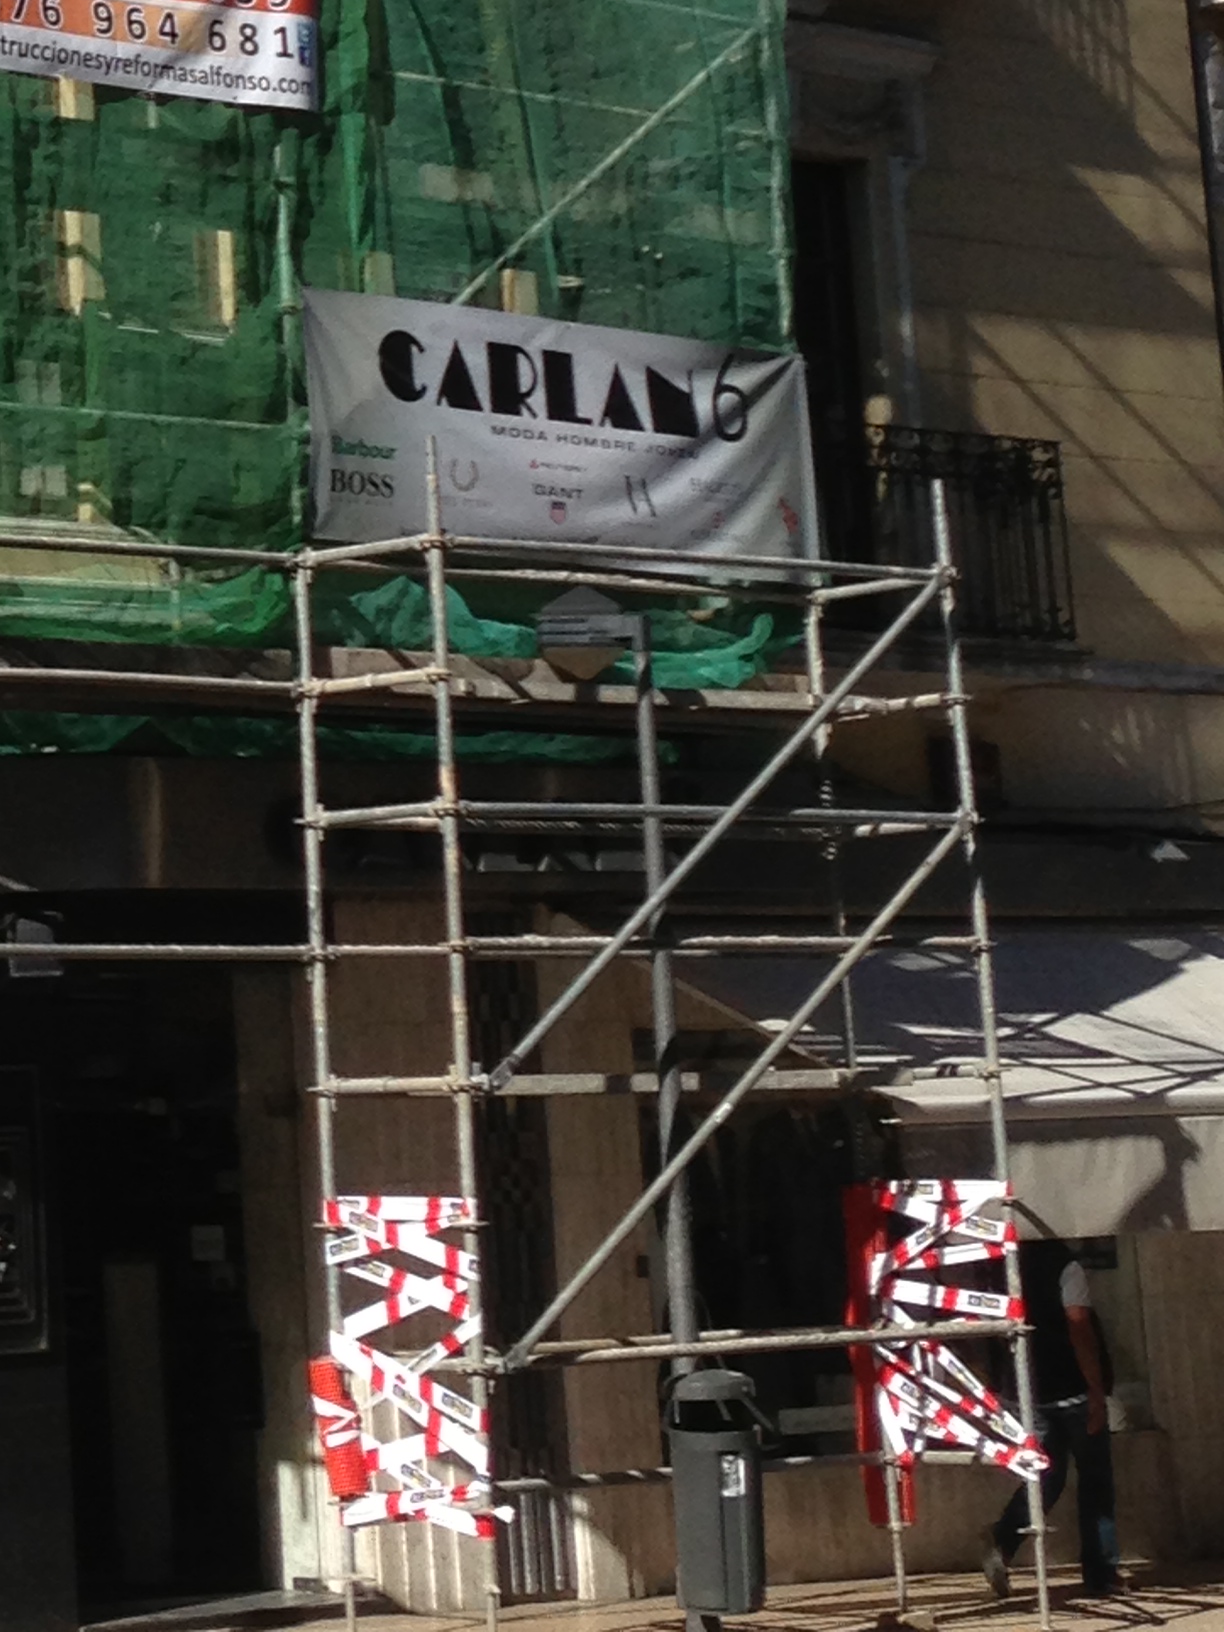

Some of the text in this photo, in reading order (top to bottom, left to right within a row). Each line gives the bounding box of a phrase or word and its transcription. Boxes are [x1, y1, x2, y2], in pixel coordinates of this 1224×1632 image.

[92, 1, 179, 46] 964
[207, 20, 295, 60] 681
[330, 434, 397, 460] Barbour
[490, 425, 548, 442] MODA
[556, 433, 636, 453] HOMBRE
[329, 468, 395, 499] BOSS
[532, 483, 583, 500] GANT
